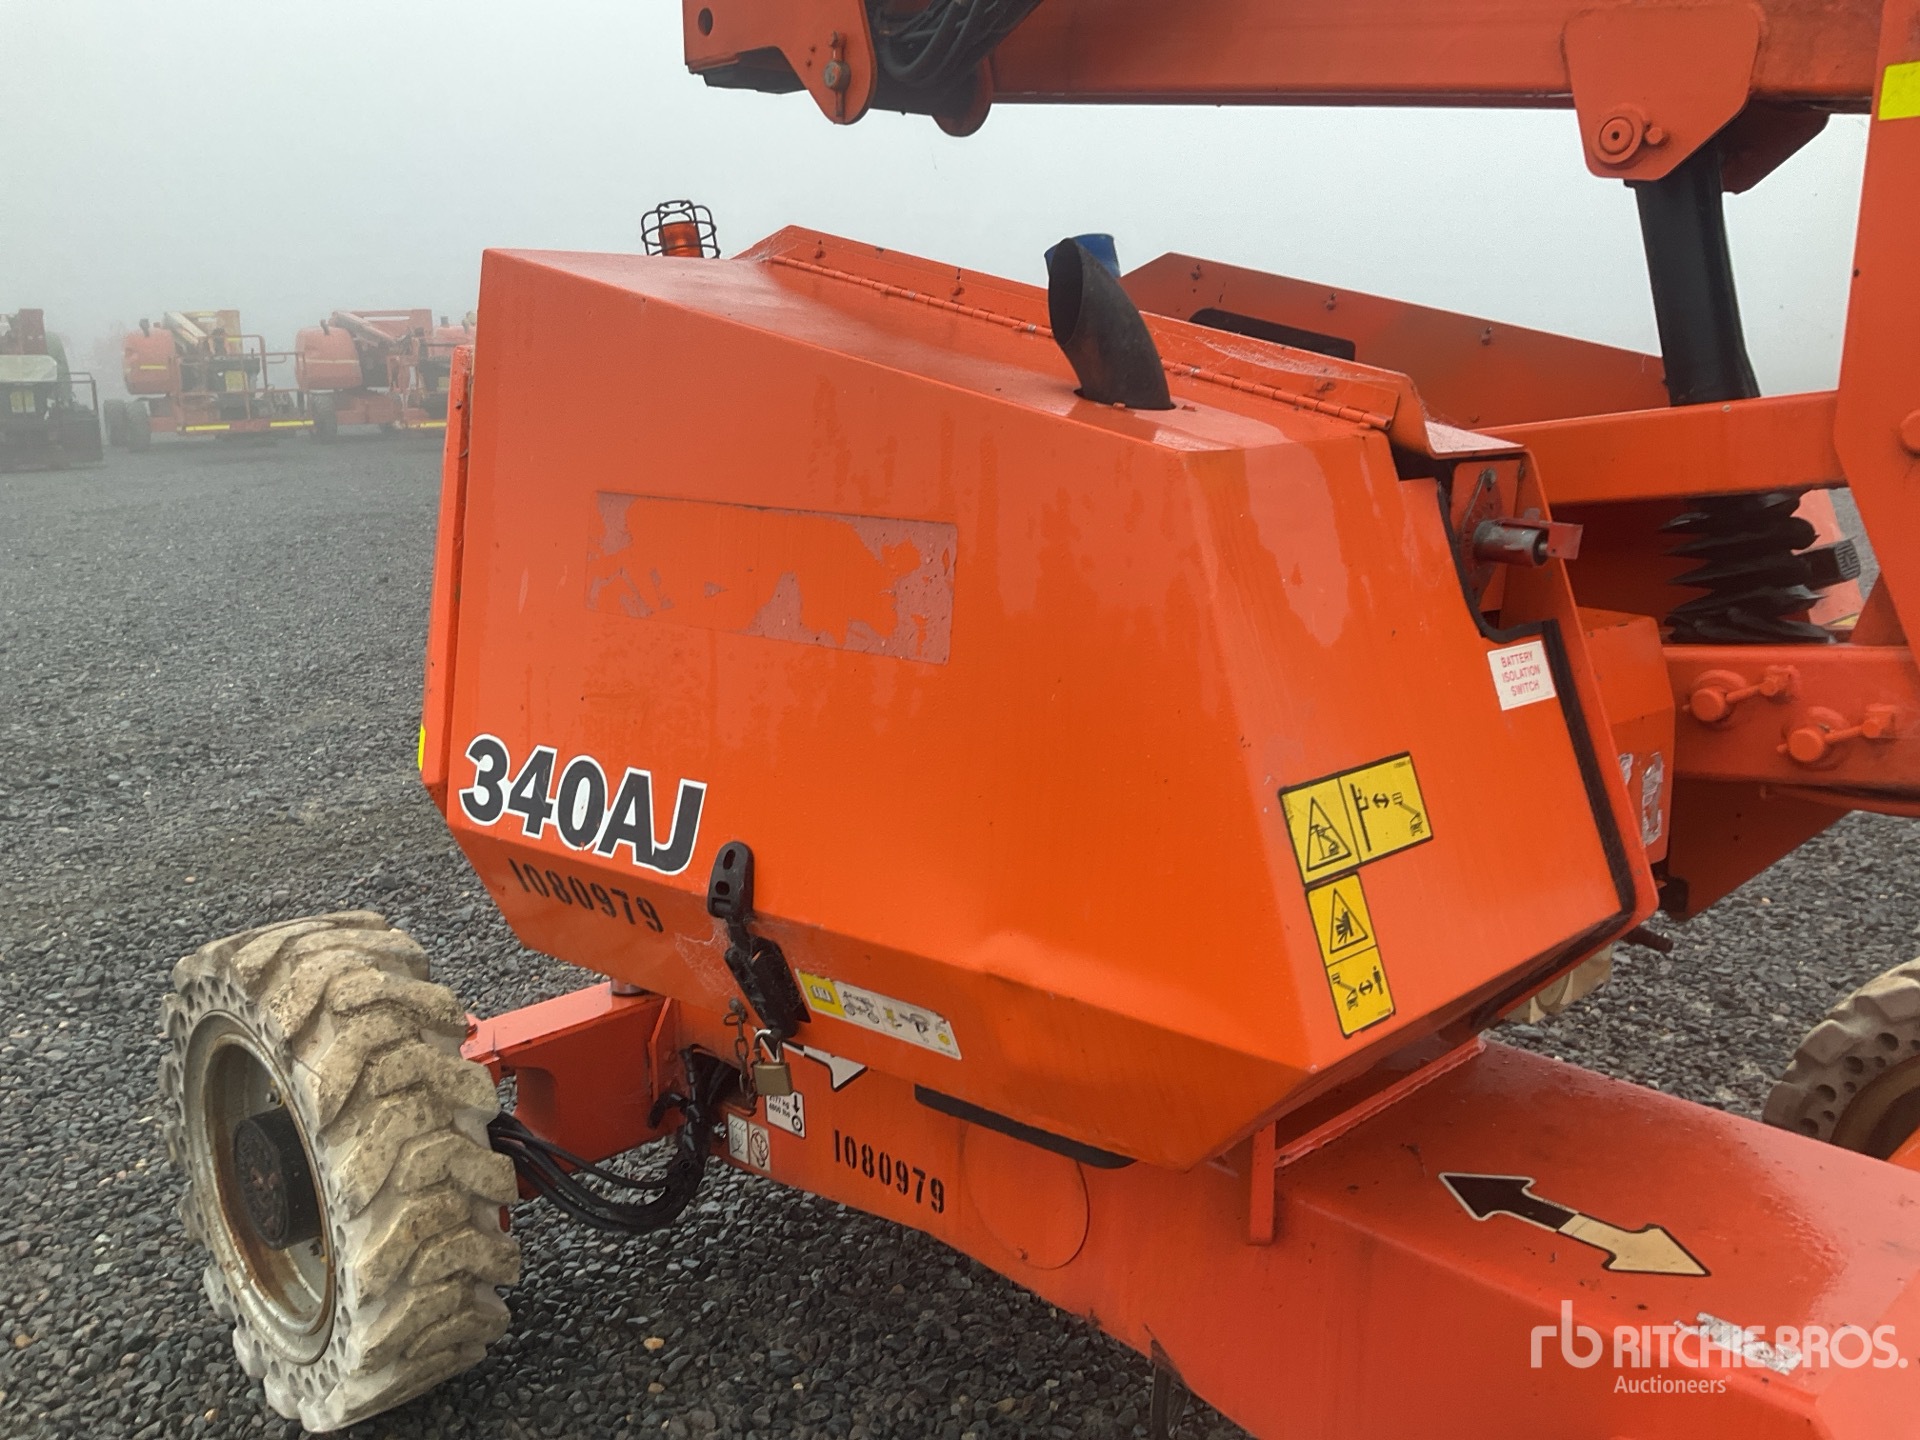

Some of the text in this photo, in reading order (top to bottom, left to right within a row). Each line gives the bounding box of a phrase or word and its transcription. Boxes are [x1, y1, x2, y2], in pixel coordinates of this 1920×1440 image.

[1501, 651, 1533, 668] BATTERY
[1502, 664, 1540, 683] ISOLATION
[1511, 679, 1540, 696] SWITCH
[459, 733, 707, 875] 340AJ
[508, 857, 664, 932] 1080979
[834, 1129, 944, 1214] 1080979
